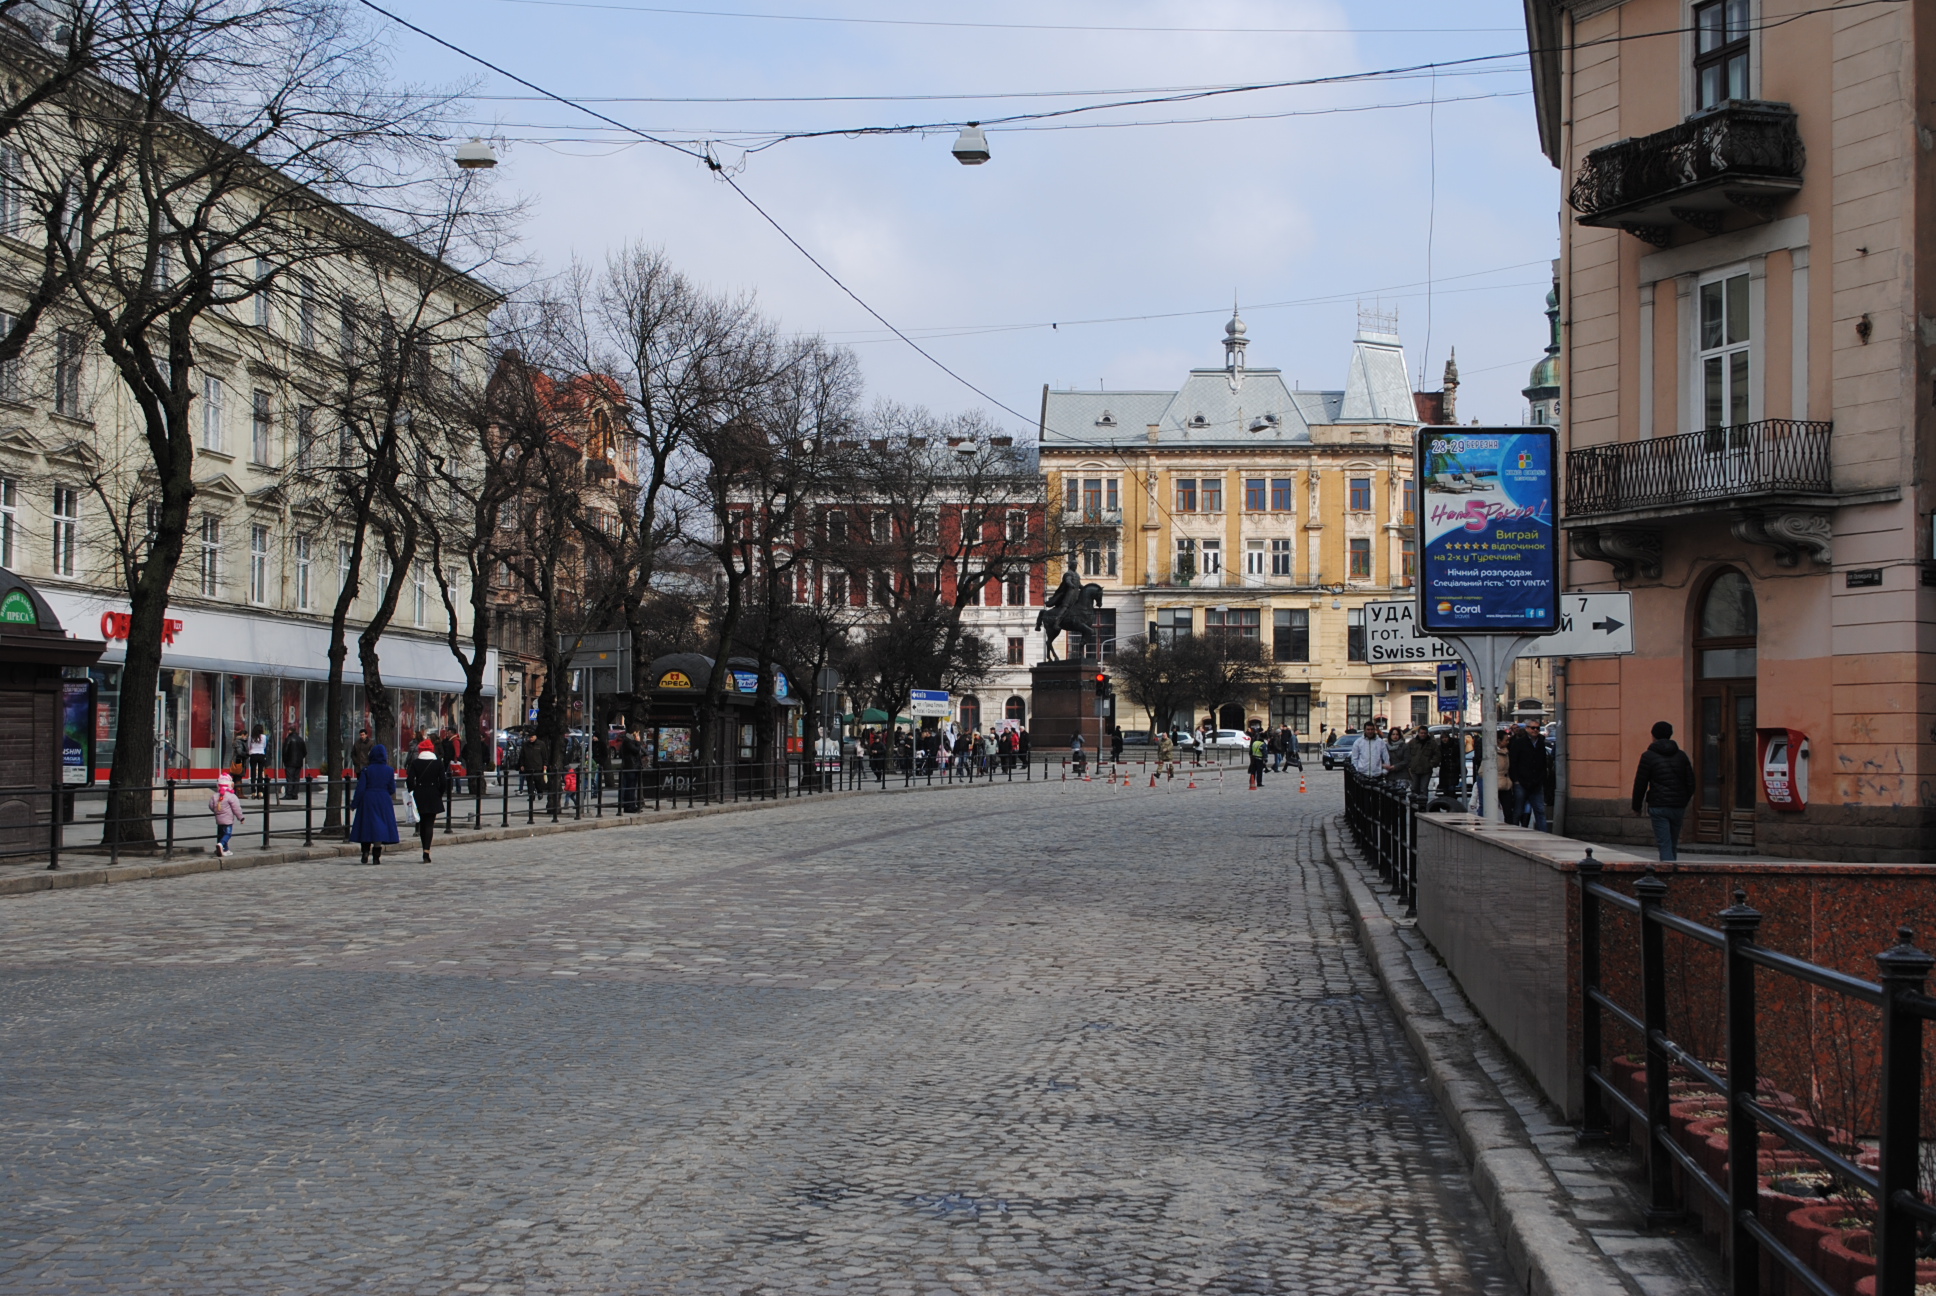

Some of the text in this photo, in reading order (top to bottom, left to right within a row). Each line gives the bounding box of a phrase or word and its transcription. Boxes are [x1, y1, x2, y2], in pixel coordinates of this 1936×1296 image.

[1431, 439, 1466, 453] 28-29
[1464, 500, 1487, 531] 5
[1496, 530, 1539, 541] Виграй
[1491, 542, 1546, 551] відпочинок
[1447, 553, 1461, 561] 2-х
[1463, 554, 1470, 563] у
[1471, 552, 1521, 562] Туреччині!
[1447, 568, 1479, 576] Нічний
[1433, 579, 1482, 587] Спеціальний
[1523, 579, 1550, 587] VINTA"
[1453, 604, 1481, 614] Coral
[1578, 597, 1588, 612] 7
[6, 611, 30, 621] ПРЕСА
[1371, 606, 1413, 623] УДА
[1371, 626, 1404, 641] гот.
[1372, 642, 1457, 660] Swiss Ho
